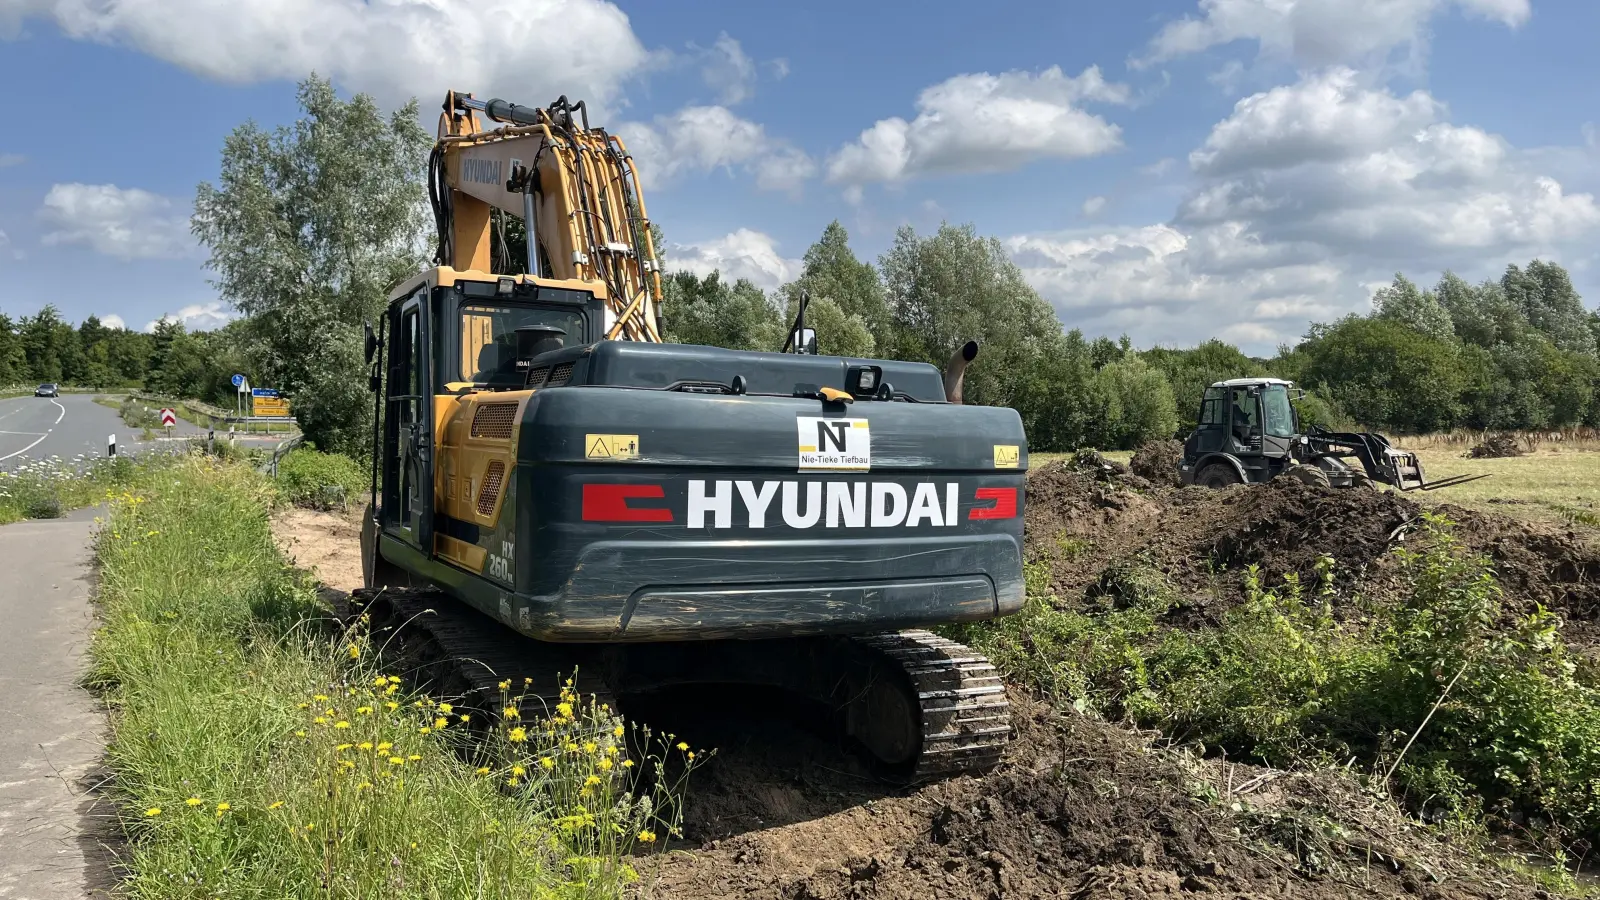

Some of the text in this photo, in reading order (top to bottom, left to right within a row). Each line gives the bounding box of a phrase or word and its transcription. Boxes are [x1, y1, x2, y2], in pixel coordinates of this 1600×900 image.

[463, 158, 503, 186] HYUNDAI
[817, 421, 851, 453] NT
[801, 455, 868, 464] Nie-Tieke Tiefbau
[687, 479, 959, 528] HYUNDAI
[502, 540, 514, 560] HX
